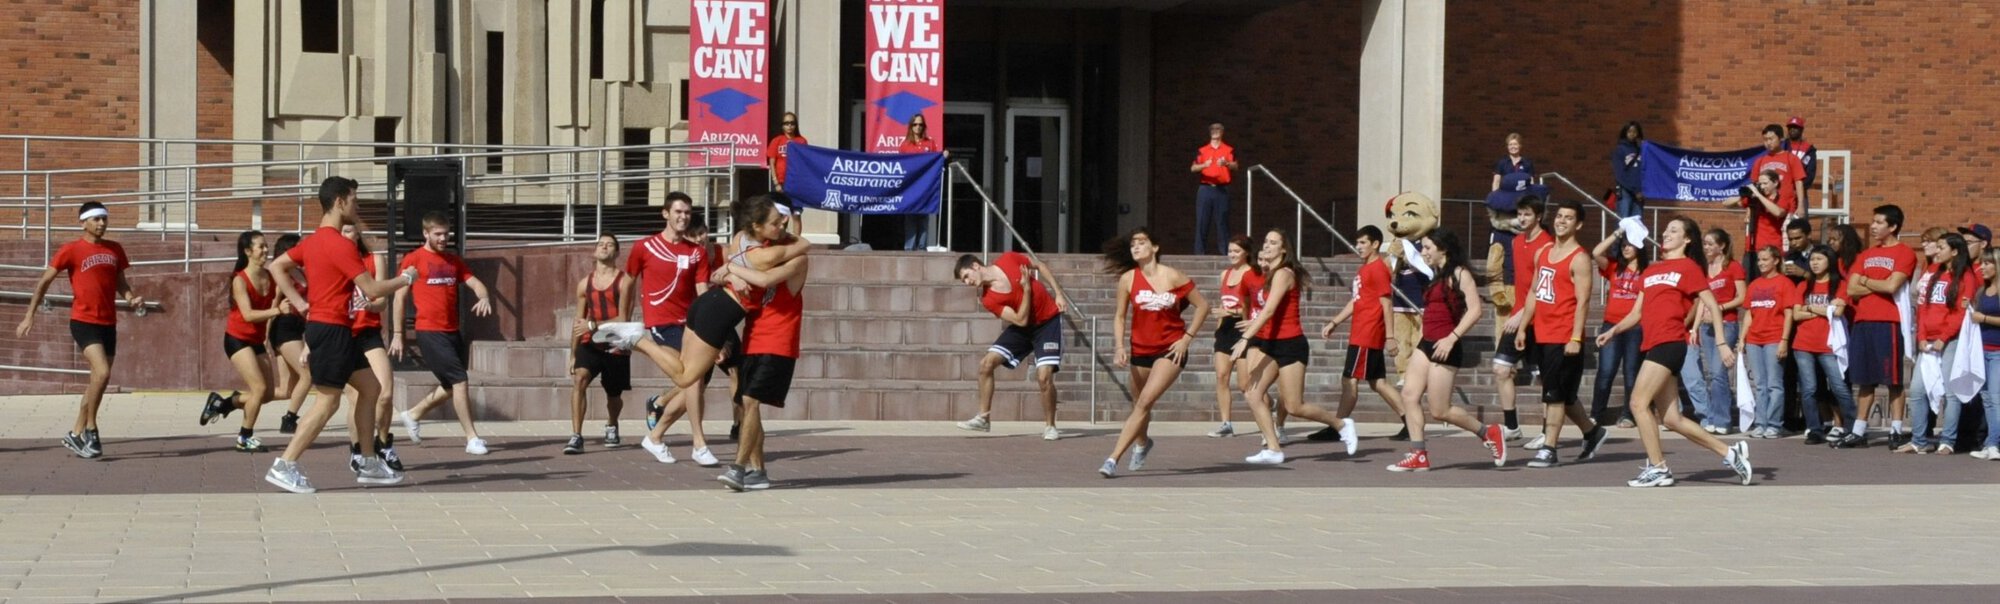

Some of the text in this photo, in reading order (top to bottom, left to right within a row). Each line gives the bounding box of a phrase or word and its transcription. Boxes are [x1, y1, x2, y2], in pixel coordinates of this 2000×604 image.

[694, 0, 765, 45] WE
[869, 5, 939, 49] WE
[694, 46, 765, 83] CAN!
[870, 51, 940, 86] CAN!
[877, 134, 907, 147] ARIZ
[831, 156, 904, 174] ARIZONA
[1679, 155, 1745, 168] ARIZONA
[843, 193, 858, 203] THE
[1708, 187, 1740, 197] UNIVERS
[1536, 265, 1556, 304] A
